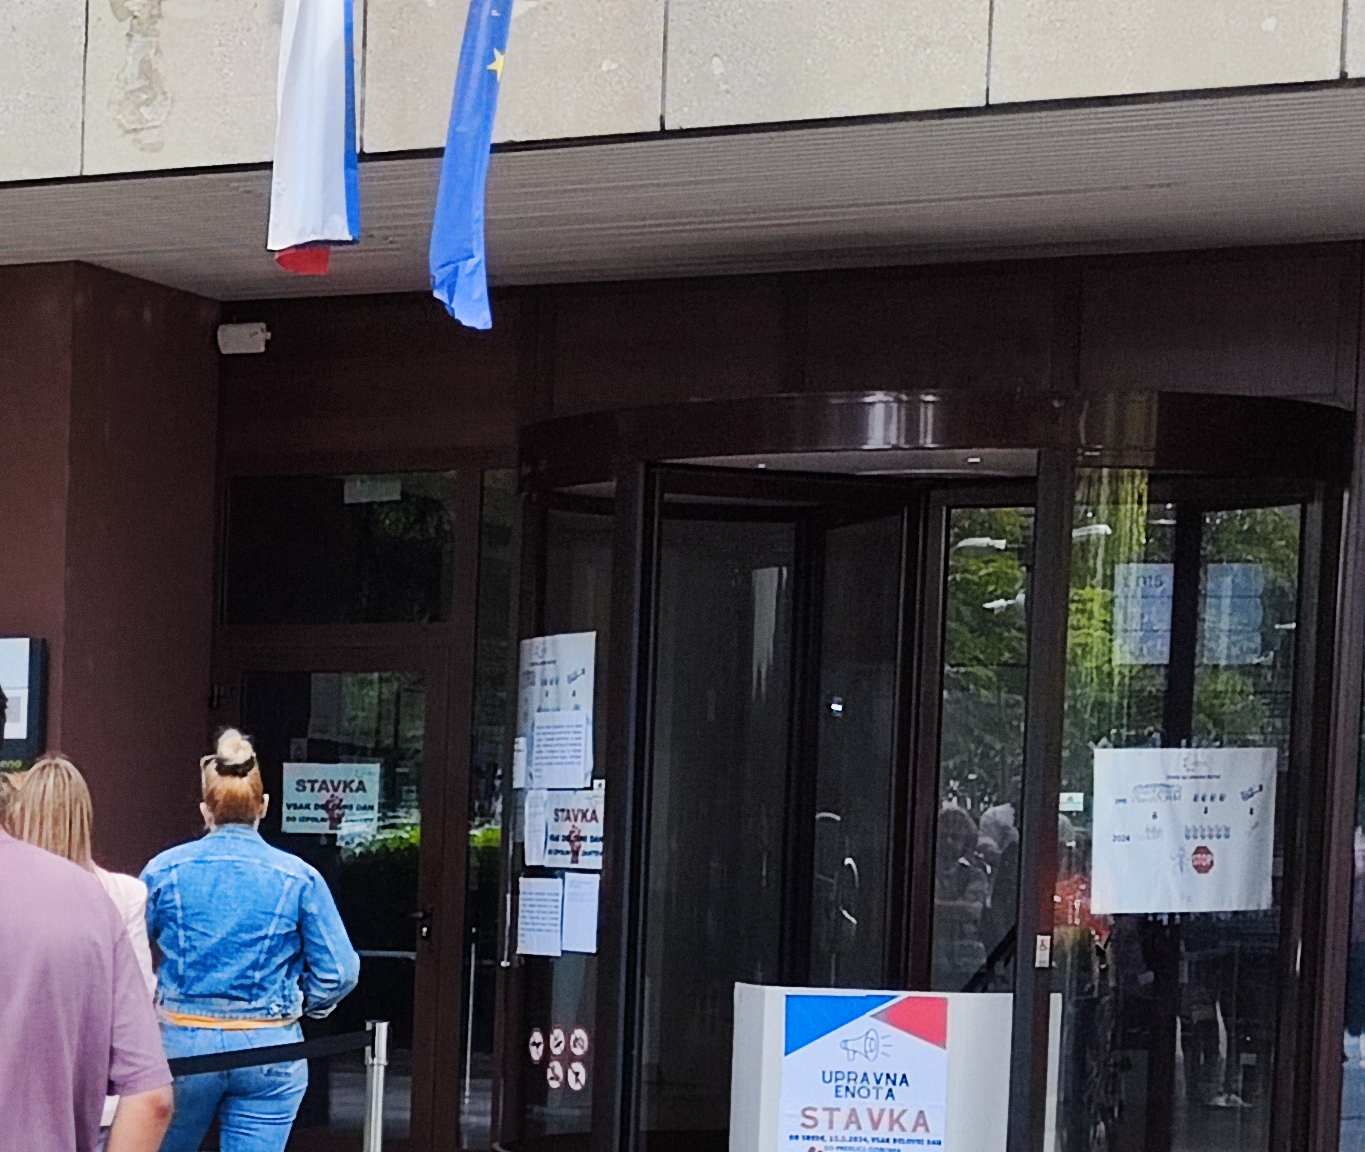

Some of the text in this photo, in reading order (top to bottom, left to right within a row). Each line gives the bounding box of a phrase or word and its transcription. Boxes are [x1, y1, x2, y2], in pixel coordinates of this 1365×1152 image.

[295, 778, 367, 794] STAVKA
[553, 807, 599, 824] STAVKA
[821, 1070, 910, 1088] UPRAVNA
[834, 1085, 896, 1101] ENOTA
[800, 1106, 931, 1134] STAVKA
